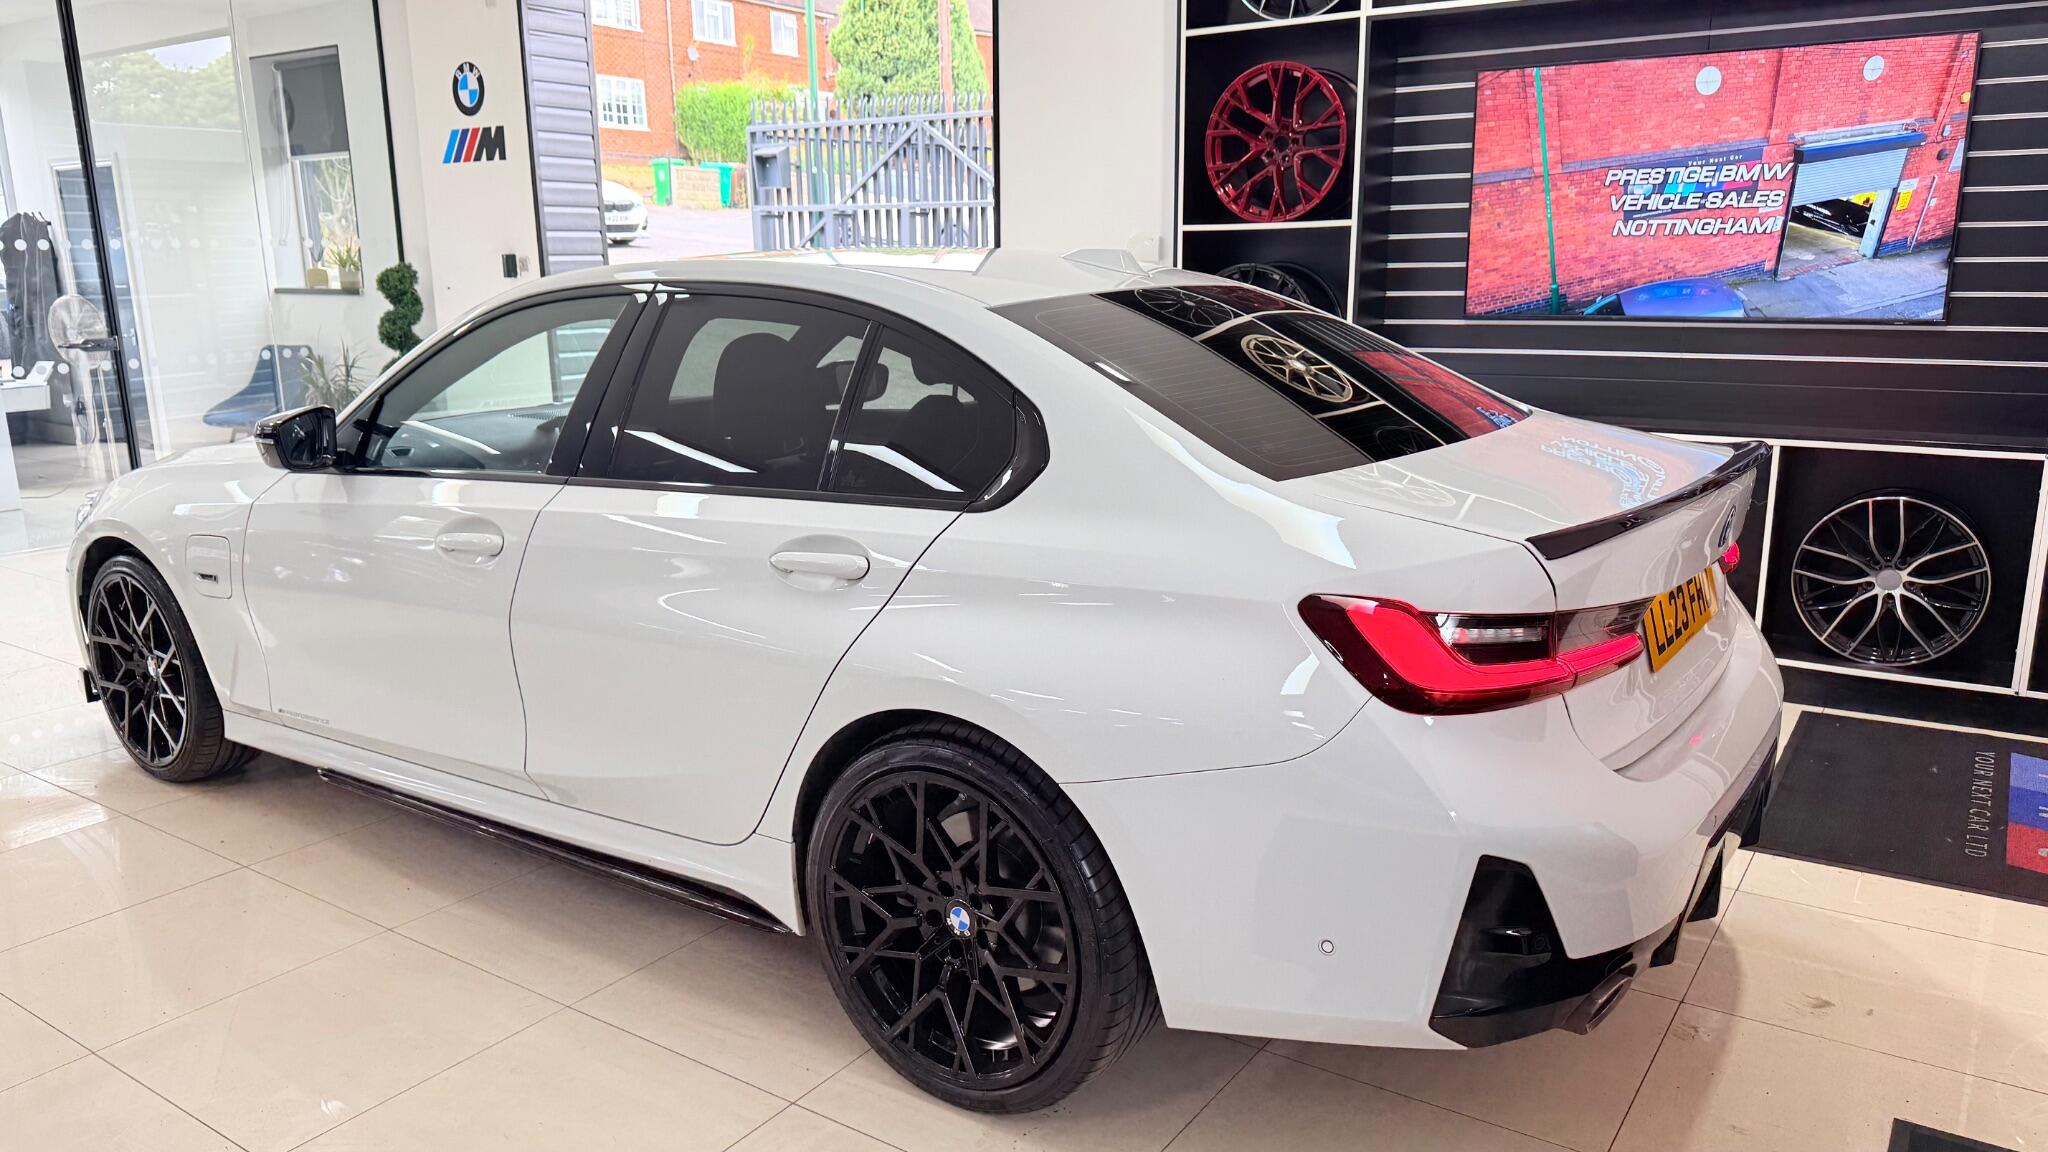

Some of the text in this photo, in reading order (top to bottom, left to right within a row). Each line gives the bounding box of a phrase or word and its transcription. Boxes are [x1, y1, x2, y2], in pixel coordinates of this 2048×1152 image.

[455, 63, 481, 79] BMW
[1604, 162, 1794, 187] PRESTIGE BMW
[1610, 189, 1786, 212] VEHICLE SALES
[1612, 217, 1776, 237] NOTTINGHAM
[1650, 584, 1689, 656] LL23
[1964, 751, 1995, 858] YOUR NEXT CAR LTD
